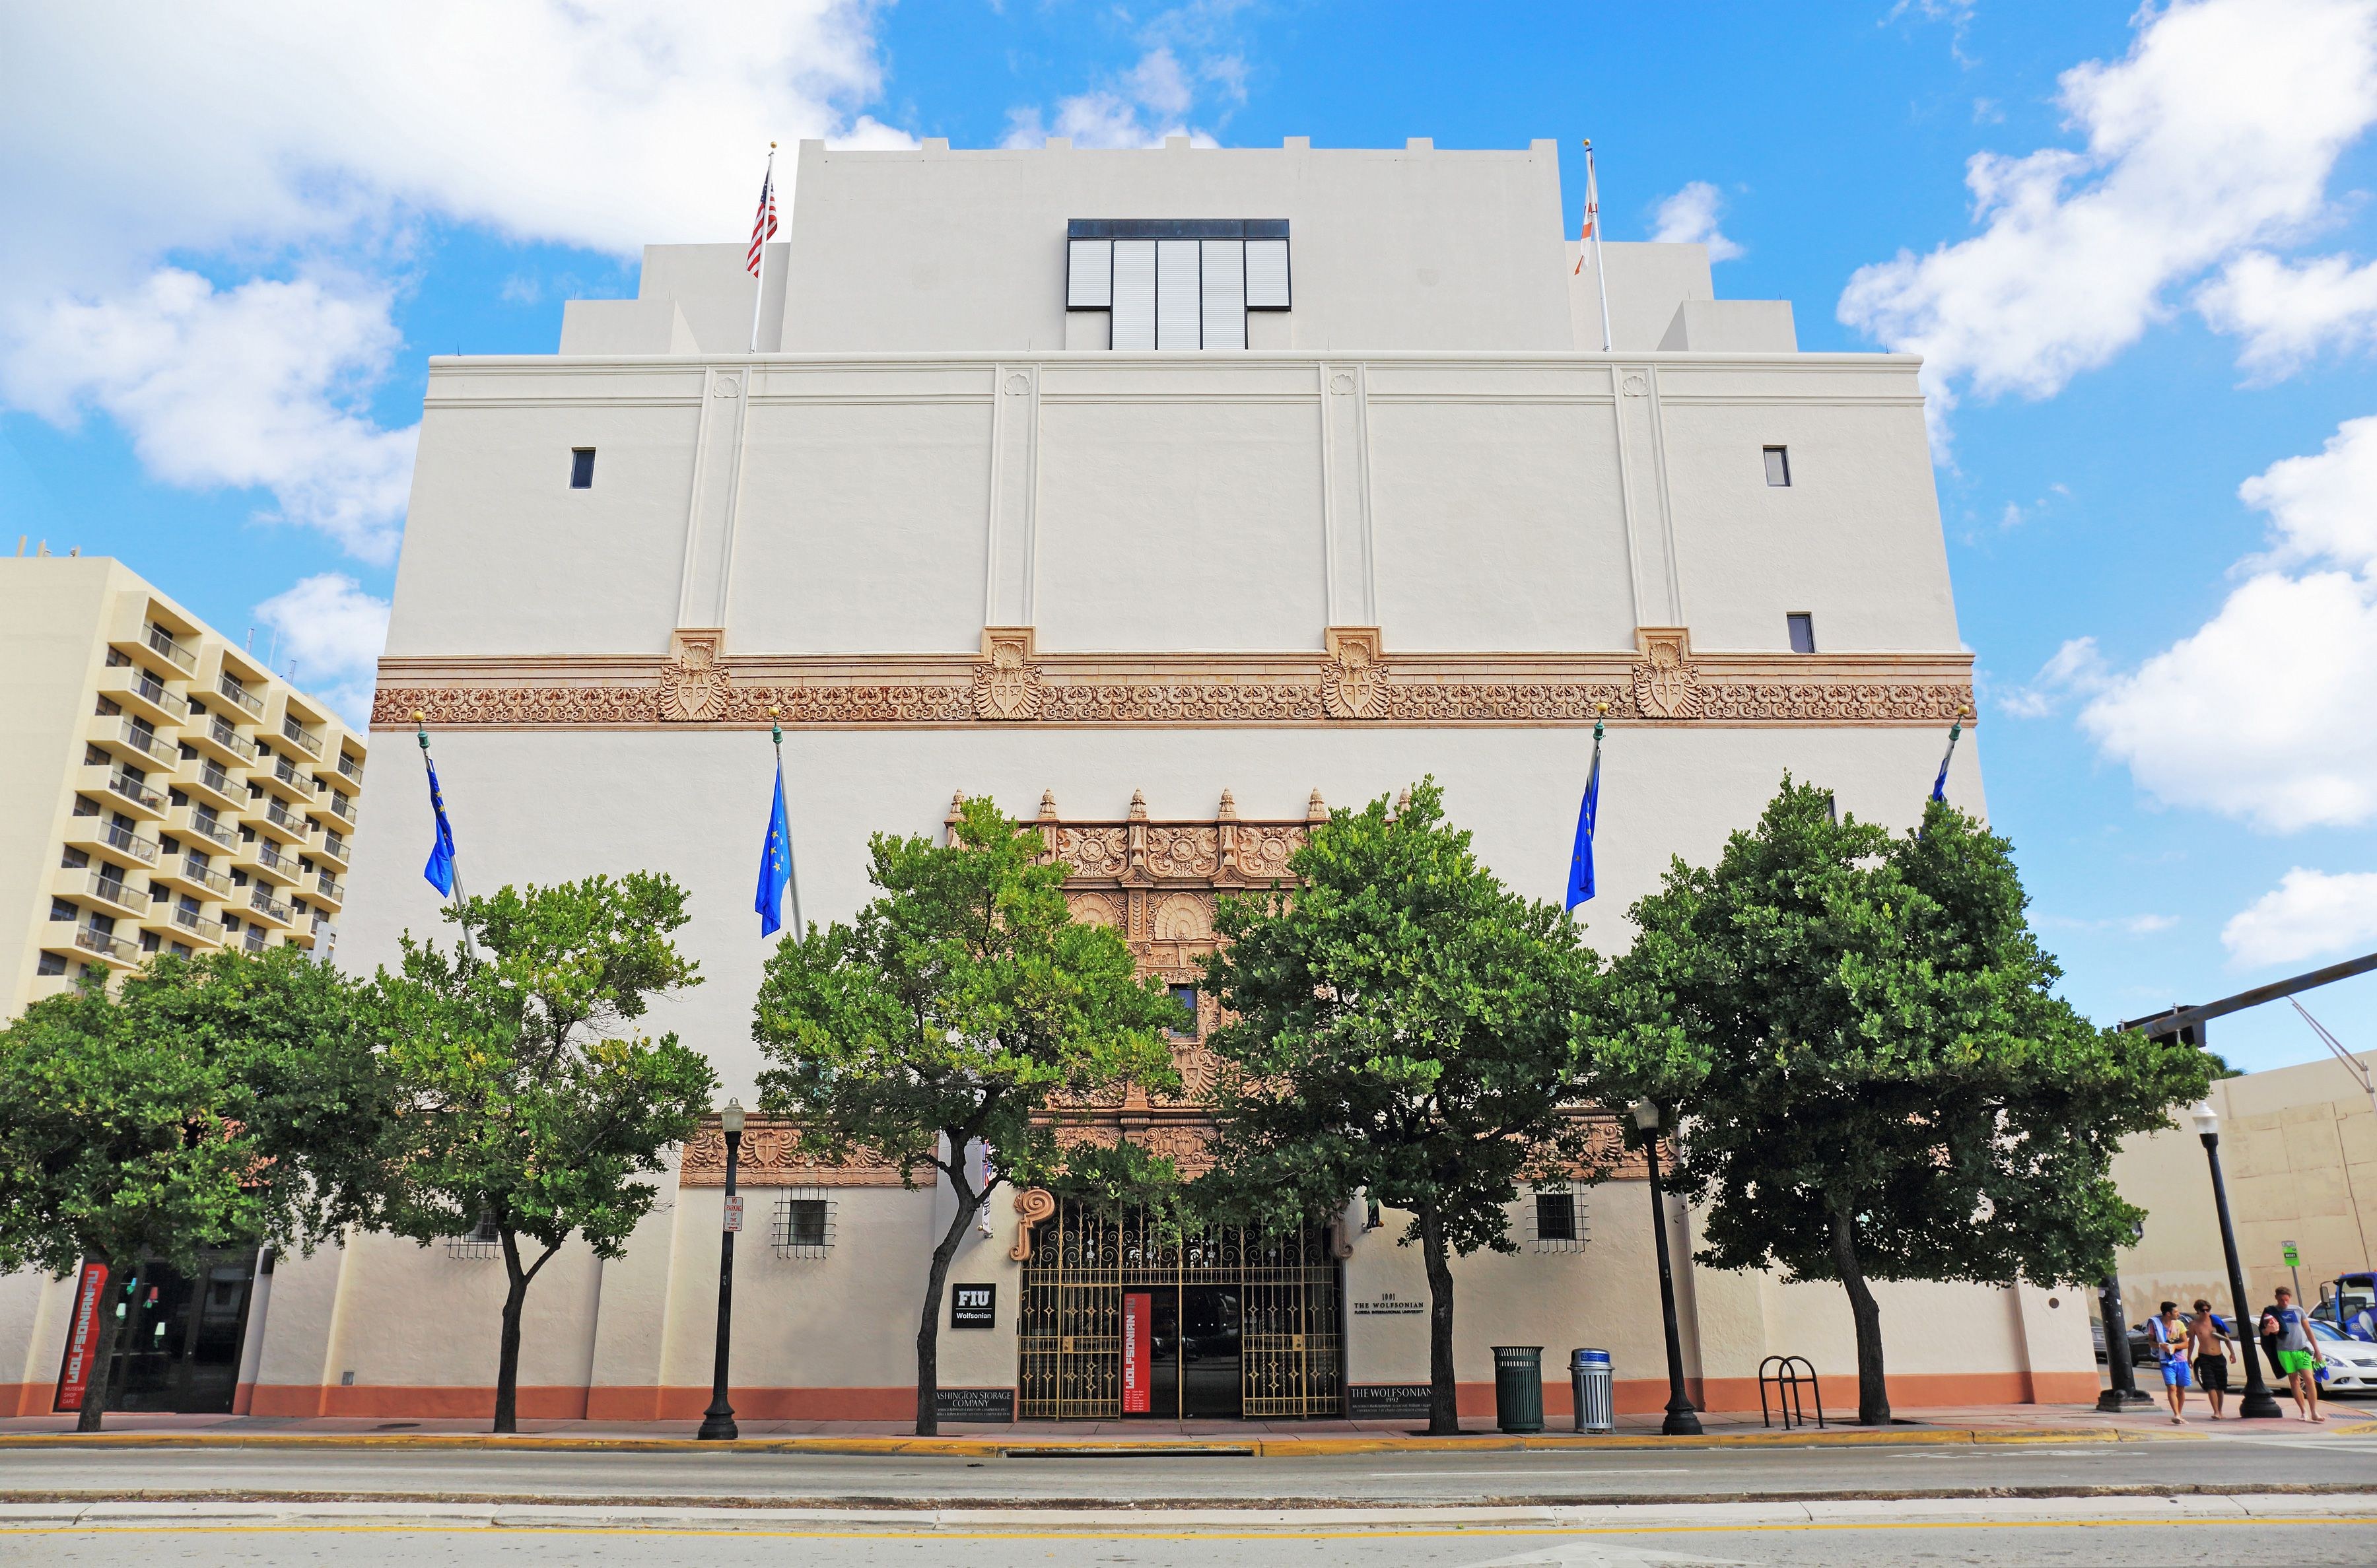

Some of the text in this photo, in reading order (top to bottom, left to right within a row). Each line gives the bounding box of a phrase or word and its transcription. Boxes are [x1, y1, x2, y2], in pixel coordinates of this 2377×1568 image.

[958, 1291, 990, 1306] FIU
[979, 1391, 1012, 1400] STORAGE
[1351, 1388, 1431, 1398] THE WOLFSONIAN
